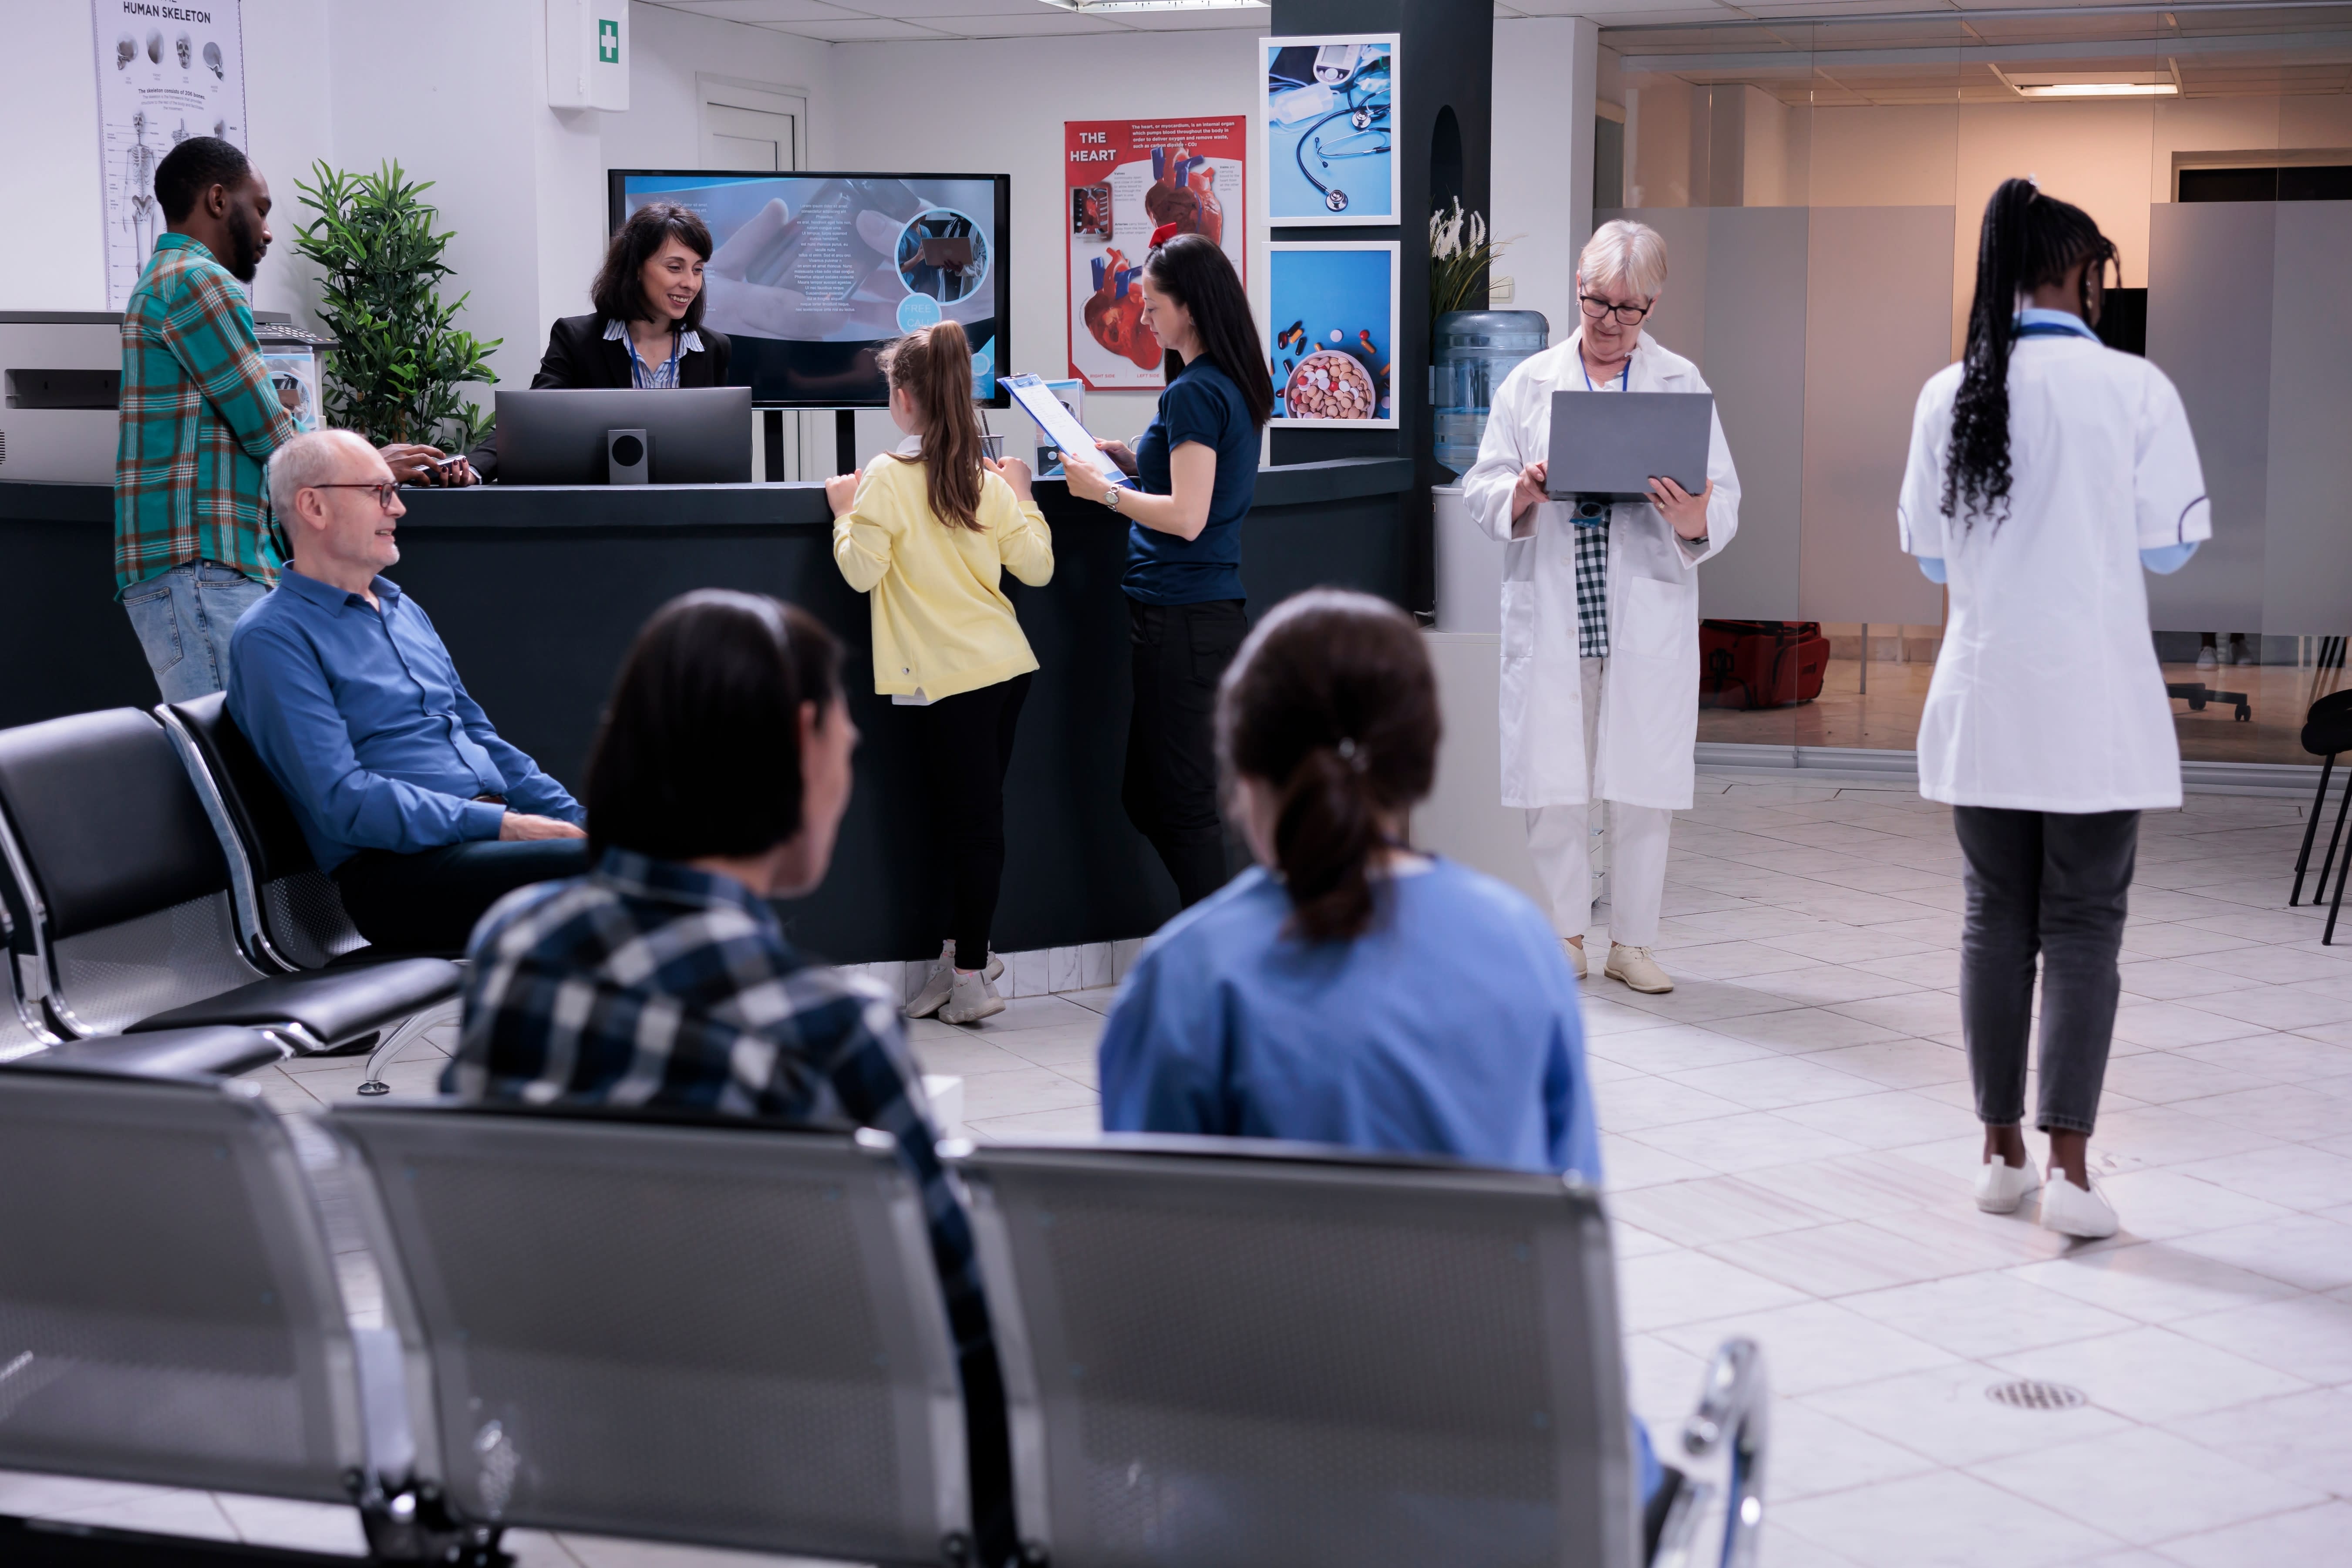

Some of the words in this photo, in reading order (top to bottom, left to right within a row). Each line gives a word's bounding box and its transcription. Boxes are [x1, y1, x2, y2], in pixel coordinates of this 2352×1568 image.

[124, 1, 159, 17] HUMAN
[162, 7, 211, 24] SKELETON
[1079, 132, 1106, 143] THE
[1070, 149, 1116, 162] HEART
[905, 304, 931, 313] FREE
